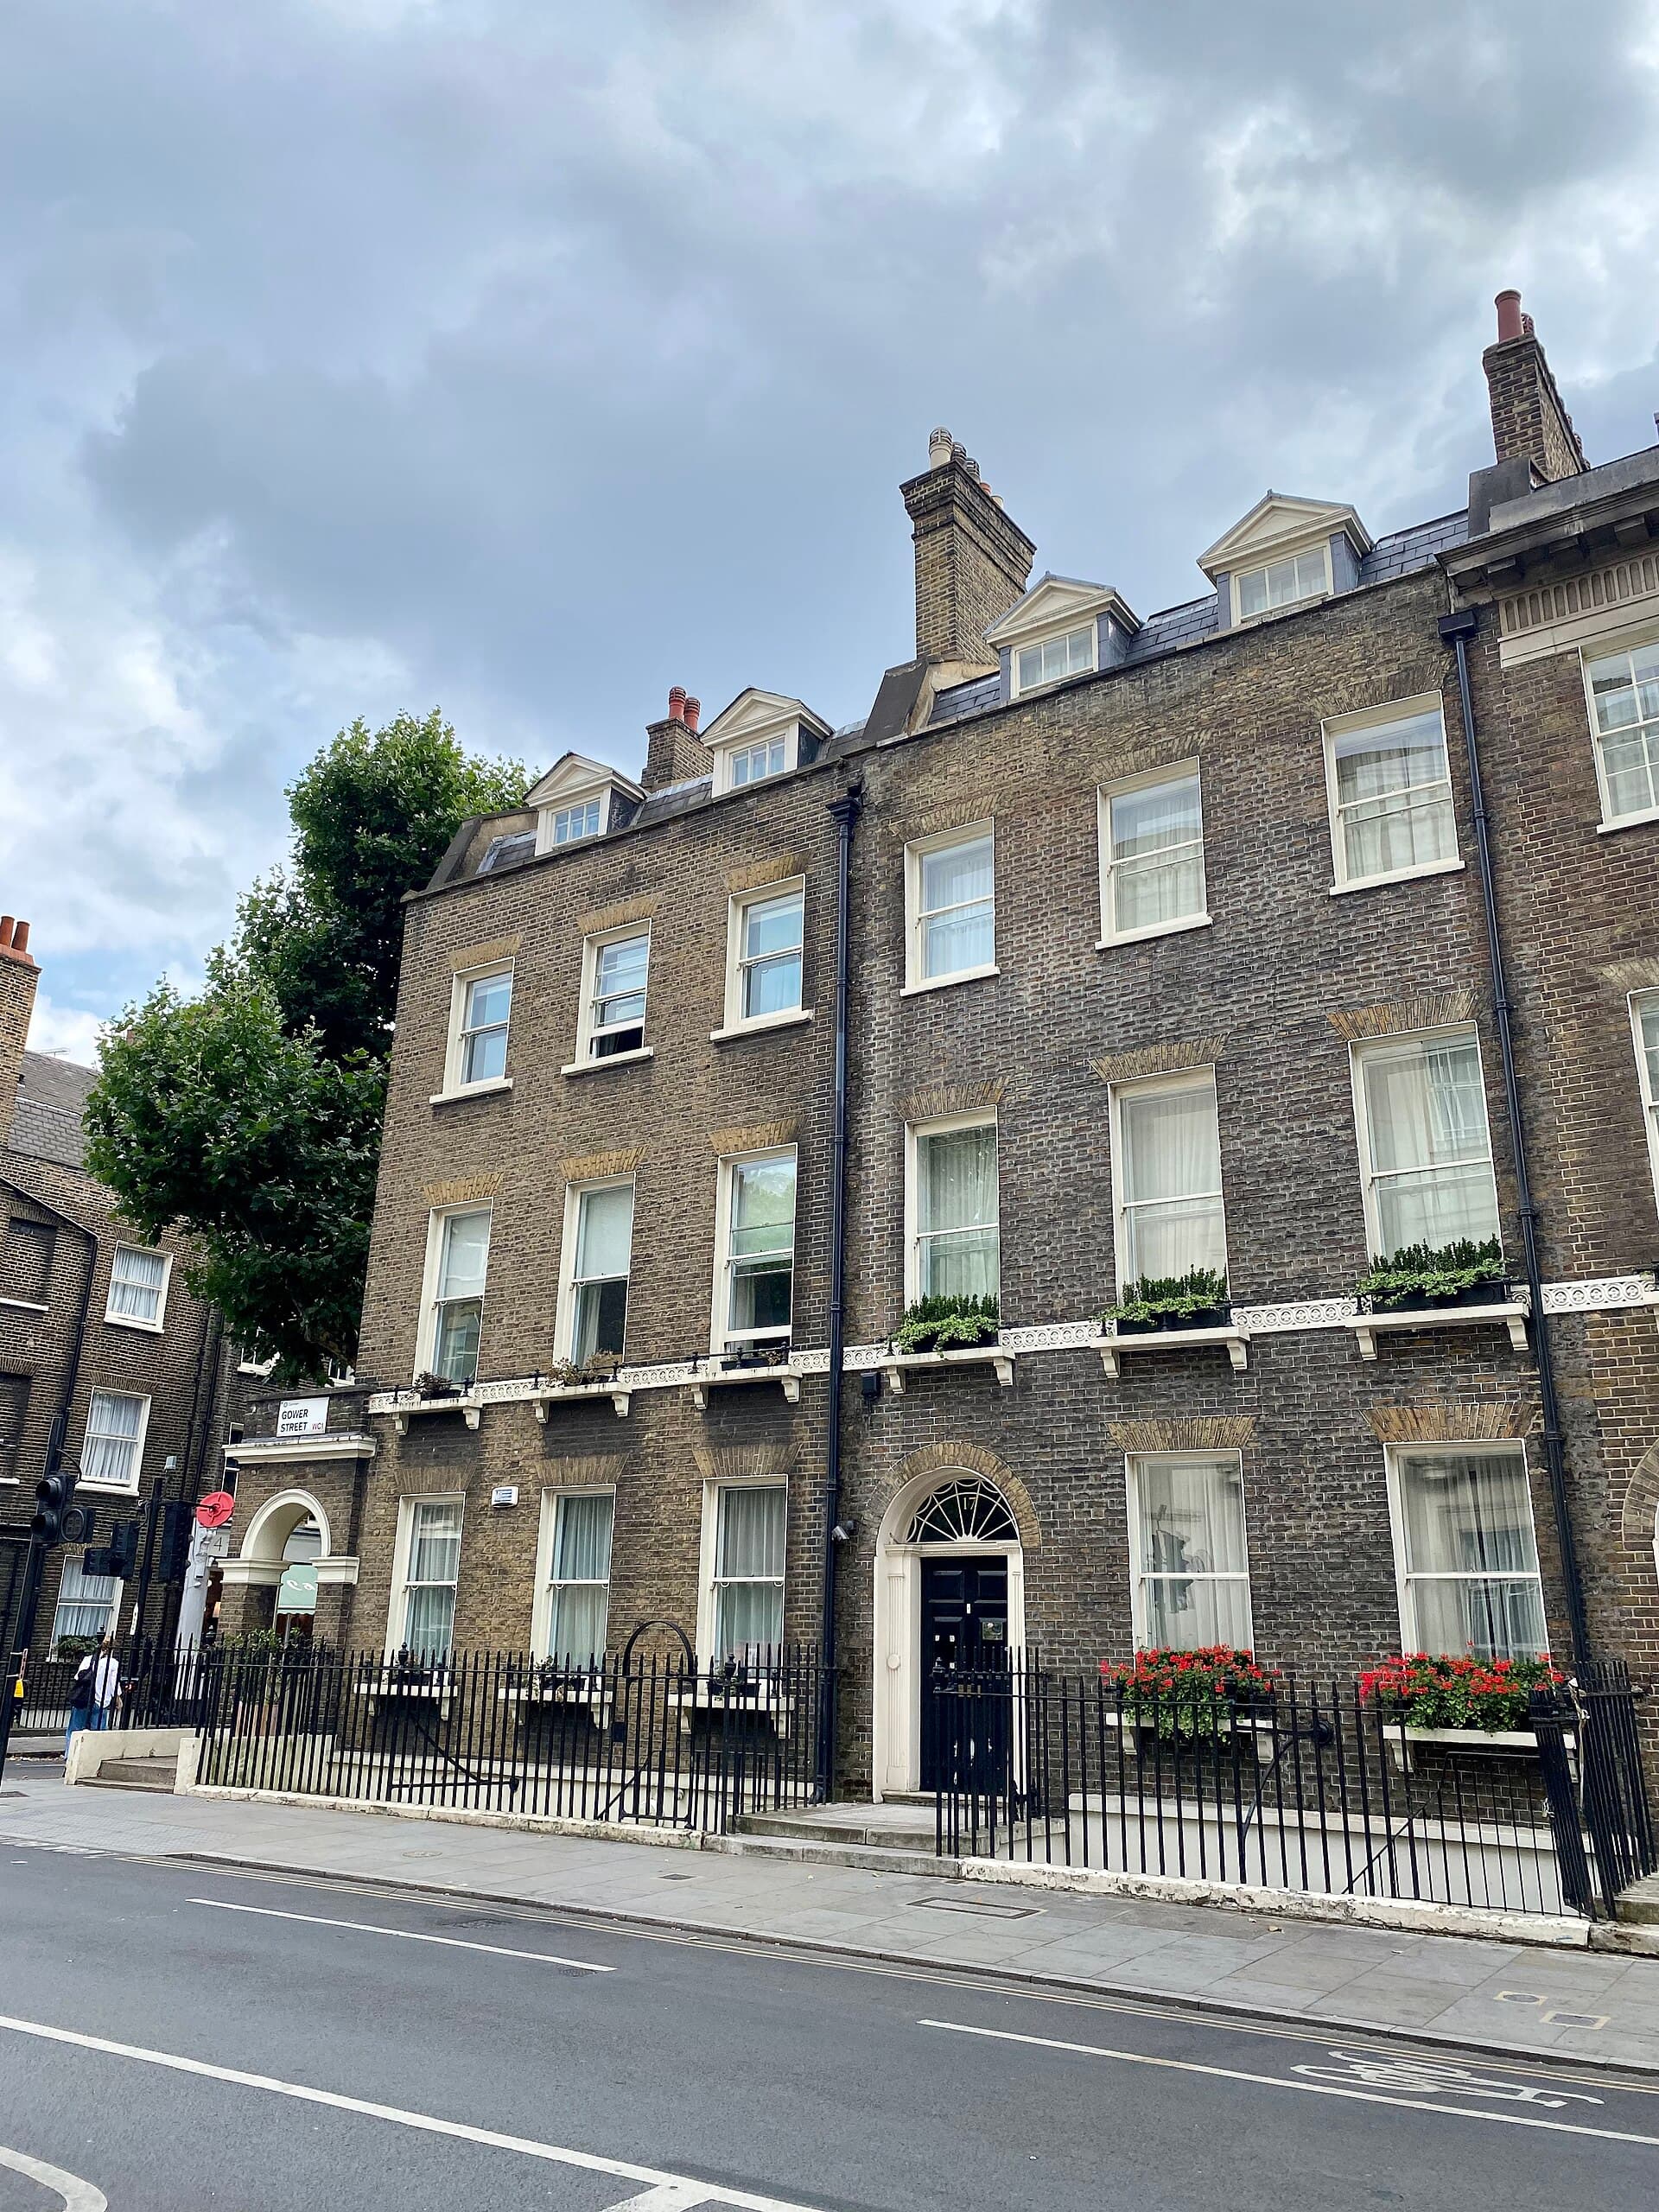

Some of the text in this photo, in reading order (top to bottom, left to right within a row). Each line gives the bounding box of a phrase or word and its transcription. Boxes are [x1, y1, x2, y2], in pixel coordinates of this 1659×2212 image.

[282, 1408, 308, 1420] GOWER
[280, 1421, 324, 1433] STREET WC1
[963, 1497, 977, 1510] 17
